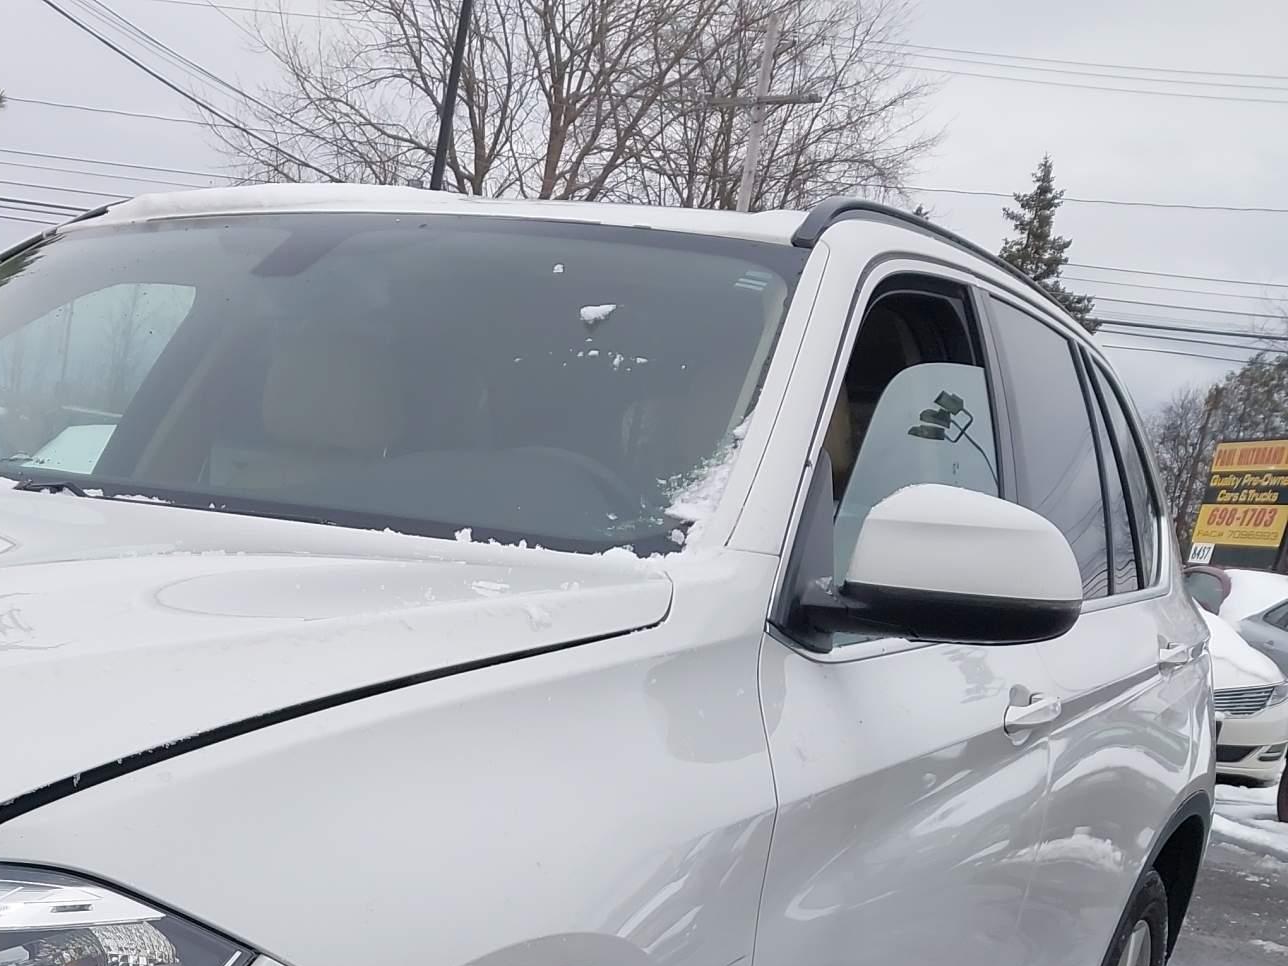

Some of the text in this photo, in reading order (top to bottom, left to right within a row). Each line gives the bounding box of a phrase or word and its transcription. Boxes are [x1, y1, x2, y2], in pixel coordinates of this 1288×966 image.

[1210, 474, 1242, 489] Quality
[1217, 490, 1240, 502] Cars
[1247, 489, 1280, 502] Trucks
[1206, 507, 1278, 528] 698-1703
